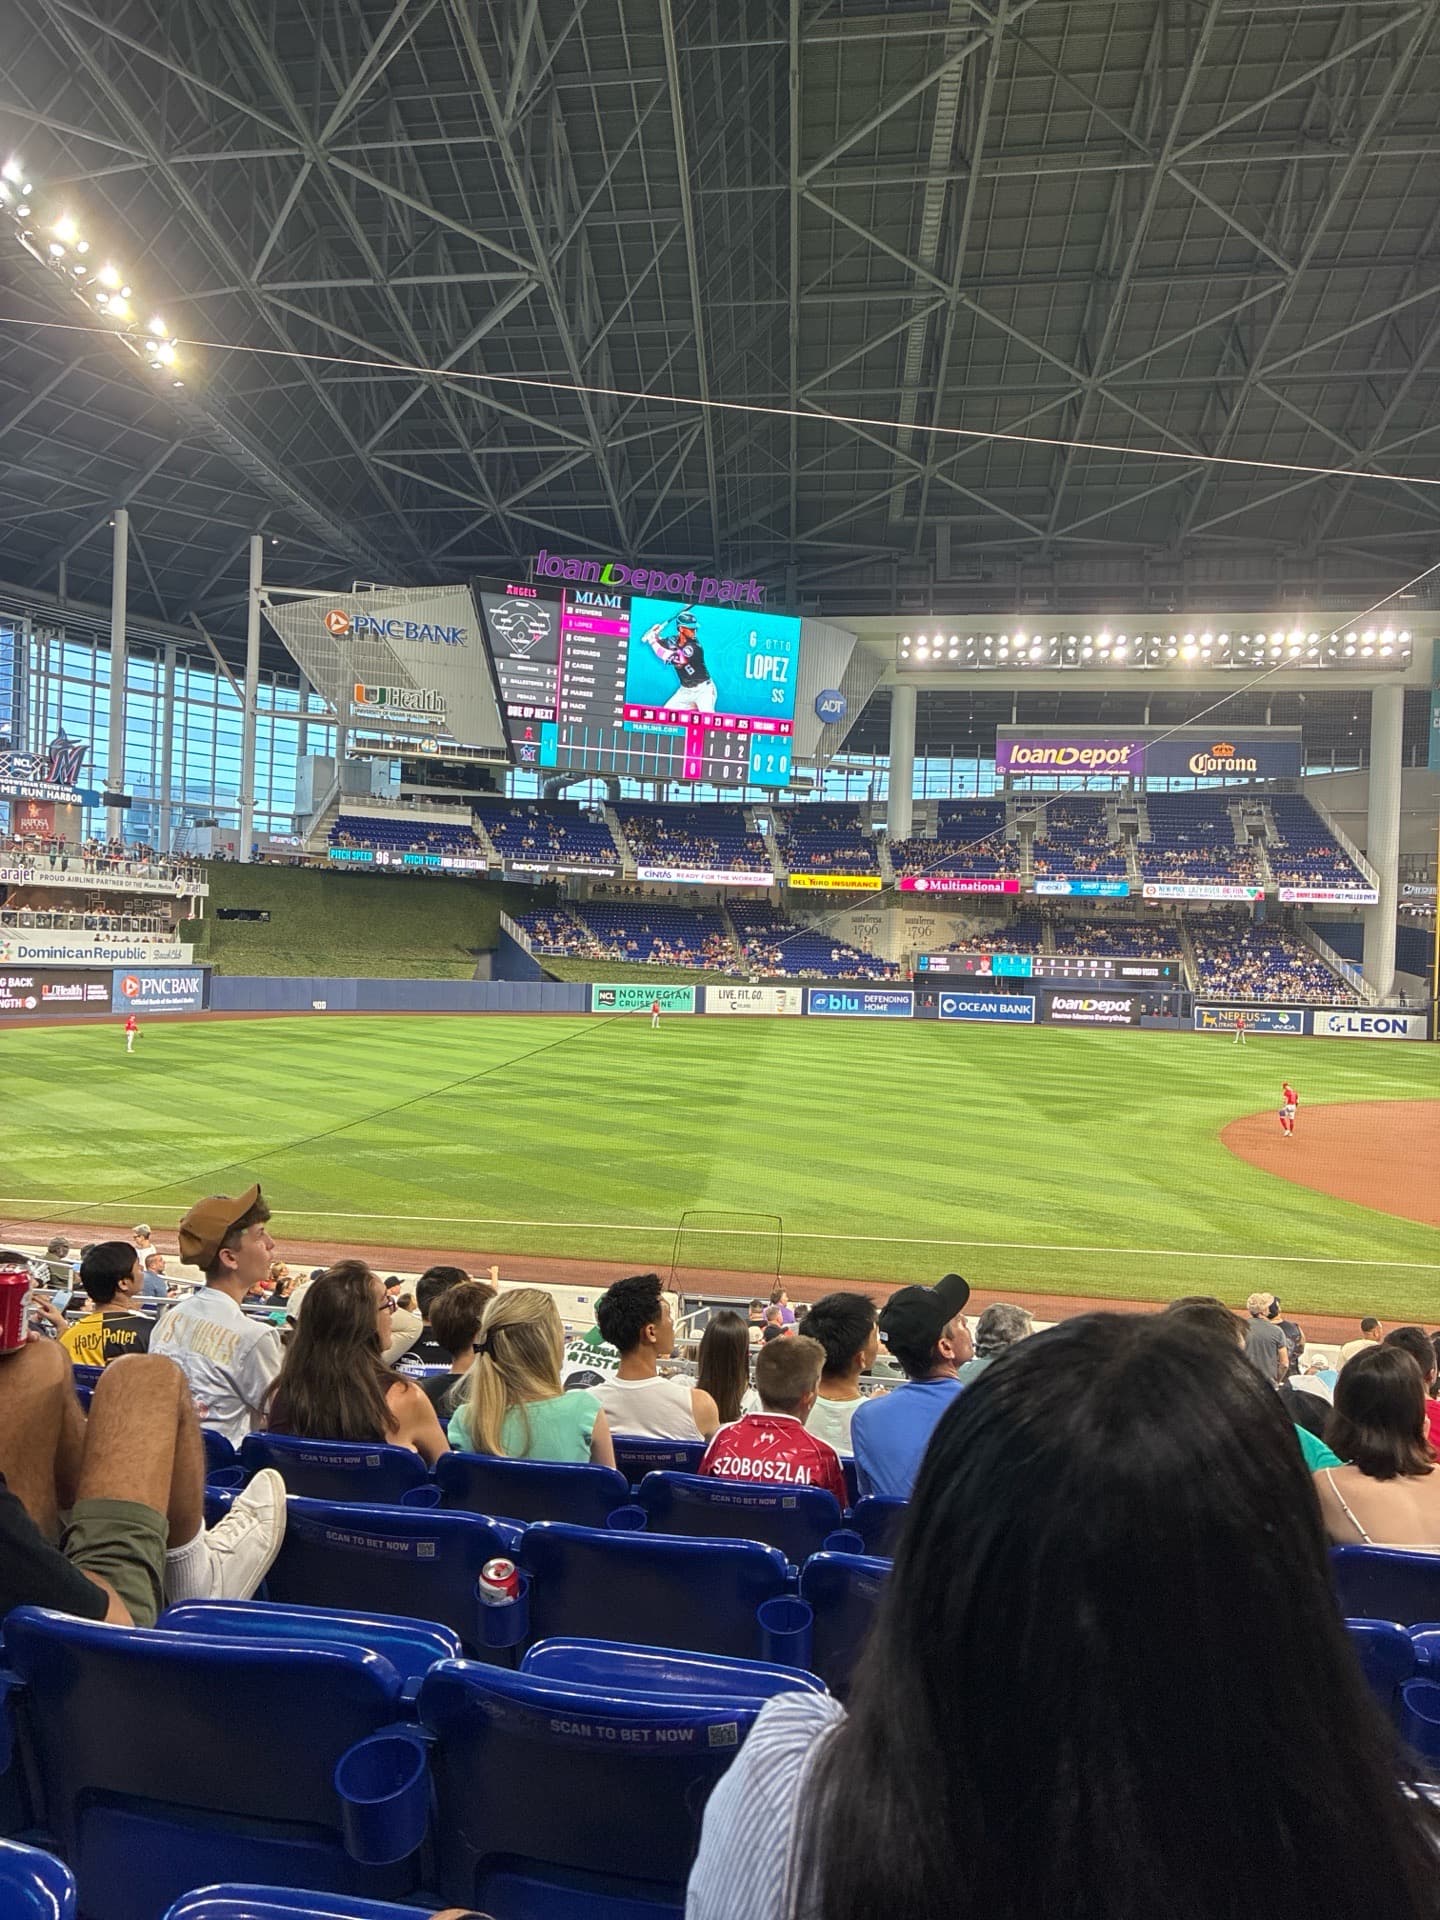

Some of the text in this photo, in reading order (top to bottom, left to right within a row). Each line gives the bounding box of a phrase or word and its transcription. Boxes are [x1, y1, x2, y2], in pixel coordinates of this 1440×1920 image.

[536, 549, 765, 605] loanDepot park
[506, 584, 537, 598] ANGELS
[575, 590, 622, 609] MIAMI
[749, 631, 791, 652] 6 OTTO
[745, 653, 790, 683] LOPEZ
[771, 687, 785, 704] SS
[507, 705, 555, 720] DUE UP NEXT
[820, 699, 844, 714] ADT
[724, 745, 731, 758] 0
[738, 746, 745, 759] 2
[1010, 745, 1131, 769] loanDepot
[13, 757, 32, 767] NCL
[753, 755, 787, 774] 0 2 0
[1188, 754, 1258, 776] Corona
[723, 766, 729, 779] 0
[736, 767, 744, 780] 2
[21, 788, 43, 798] RUN
[46, 790, 82, 803] HARBOR
[330, 849, 350, 860] PITCH
[351, 850, 372, 862] SPEED
[375, 851, 389, 865] 96
[404, 854, 424, 865] PITCH
[425, 855, 441, 866] TYPE
[1, 864, 35, 886] arajet
[39, 873, 65, 882] PROUD
[67, 876, 95, 885] AIRLINE
[96, 878, 123, 887] PARTNER
[831, 880, 879, 889] INSURANCE
[930, 880, 1005, 892] Multinational
[852, 924, 879, 939] 1796
[906, 926, 932, 940] 1796
[18, 946, 93, 959] Dominican
[94, 947, 147, 963] Republic
[8, 978, 33, 988] BACK
[599, 991, 615, 1000] NCL
[618, 990, 691, 1000] NORWEGIAN
[718, 989, 763, 1001] LIVE. FIT. GO.
[829, 994, 859, 1011] blu
[864, 994, 910, 1005] DEFENDING
[618, 999, 650, 1008] CRUISE
[864, 1003, 889, 1012] HOME
[959, 1002, 1032, 1014] OCEAN BANK
[1052, 996, 1131, 1013] loanDepot
[1346, 1018, 1408, 1034] LEON
[73, 1328, 137, 1356] Harry Potter
[578, 1353, 613, 1370] FEST
[300, 1454, 361, 1464] SCAN TO BET NOW
[713, 1455, 811, 1485] SZOBOSZLAI
[711, 1494, 777, 1506] SCAN TO BET NOW
[326, 1530, 409, 1551] SCAN TO BET NOW
[550, 1718, 694, 1742] SCAN TO BET NOW
